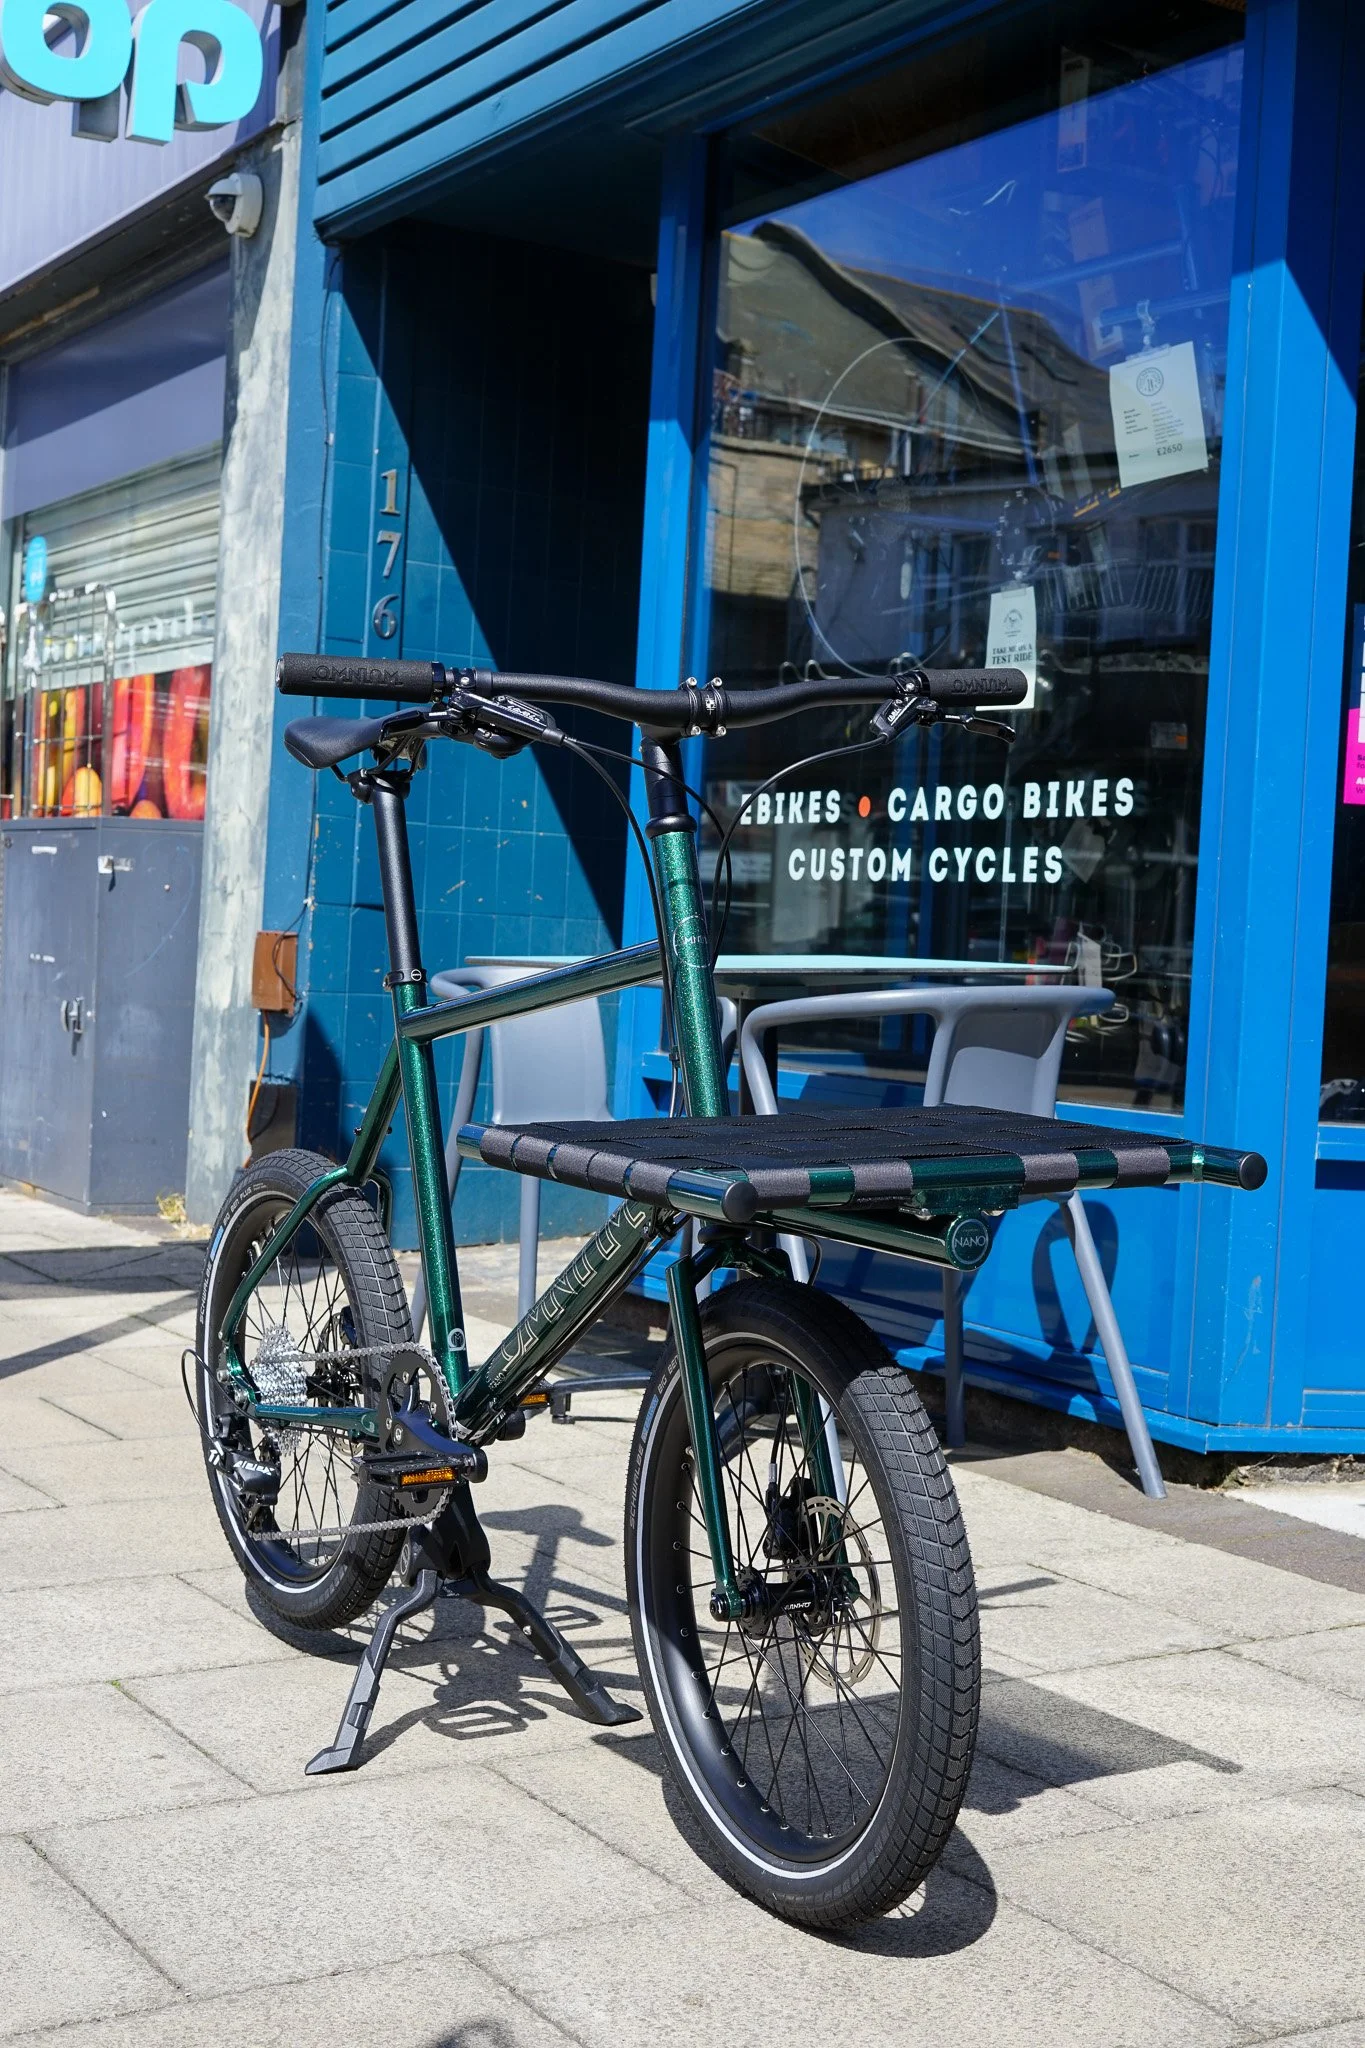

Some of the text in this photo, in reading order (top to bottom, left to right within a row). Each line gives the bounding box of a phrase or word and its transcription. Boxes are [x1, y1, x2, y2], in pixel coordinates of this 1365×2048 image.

[1157, 443, 1183, 457] £2650
[992, 651, 1033, 665] TEST RIDE
[887, 783, 1004, 822] CARGO
[1022, 777, 1134, 819] BIKES
[788, 846, 911, 882] CUSTOM
[928, 845, 1063, 884] CYCLES
[199, 1261, 212, 1325] SCHWALBE
[240, 1186, 252, 1201] PLUS
[955, 1235, 986, 1248] NANO
[629, 1445, 644, 1530] SCHWALBE
[657, 1375, 667, 1394] BIG
